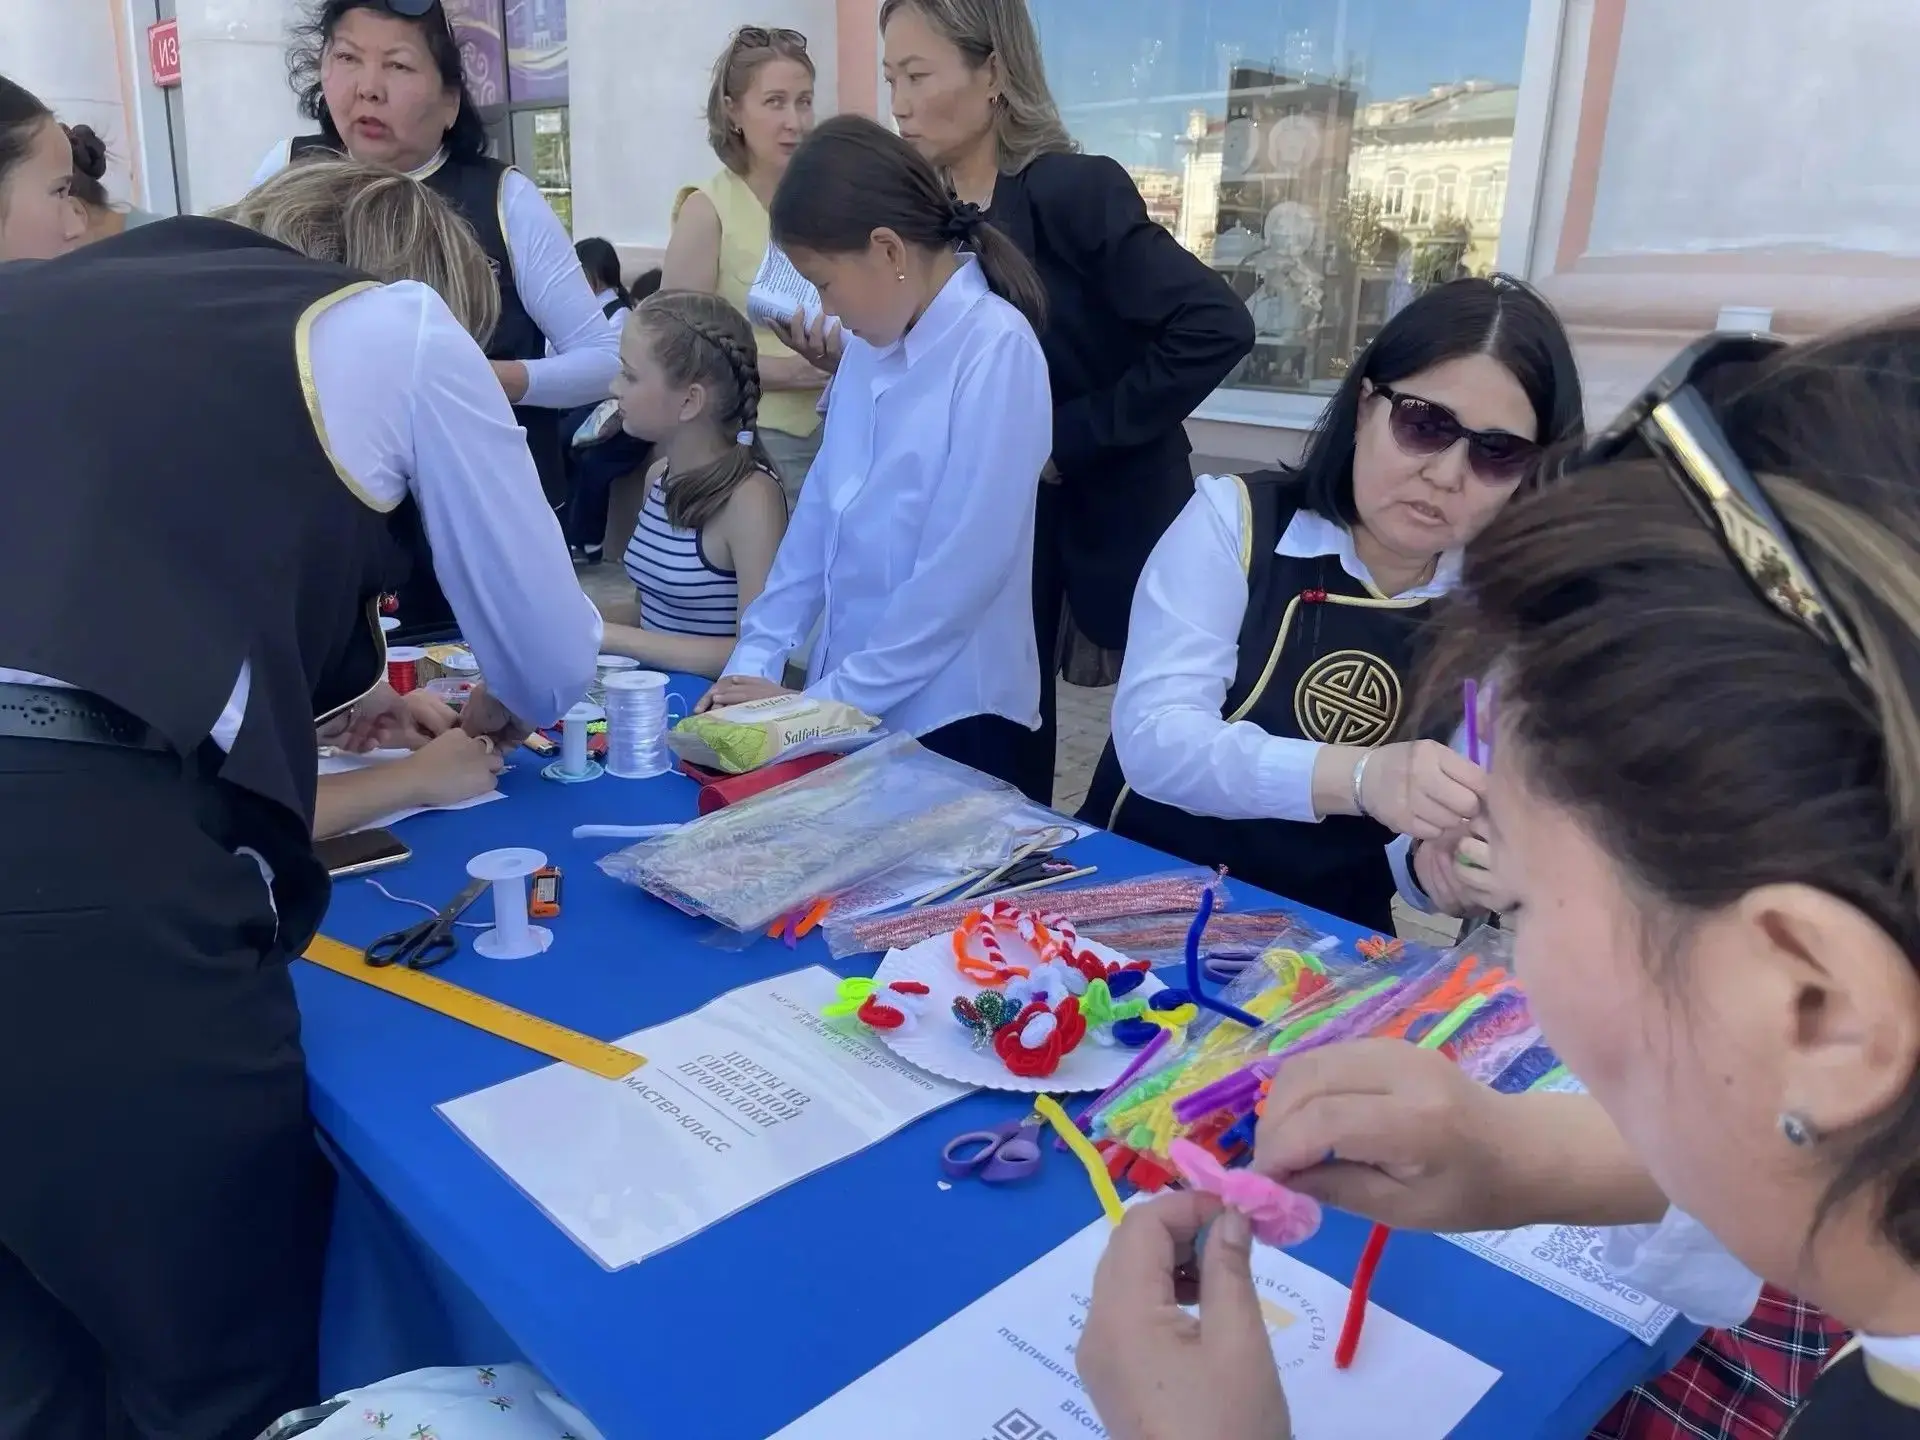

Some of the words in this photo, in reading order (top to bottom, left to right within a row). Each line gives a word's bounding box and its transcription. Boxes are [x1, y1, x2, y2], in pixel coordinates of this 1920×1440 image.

[677, 1062, 779, 1128] ПРОВОЛОКИ
[696, 1054, 804, 1121] СИНЕЛЬНОЙ
[723, 1051, 786, 1089] ЦВЕТЫ
[781, 1087, 811, 1107] ИЗ
[622, 1076, 732, 1153] МАСТЕР-КЛАСС
[997, 1326, 1088, 1393] подпишите
